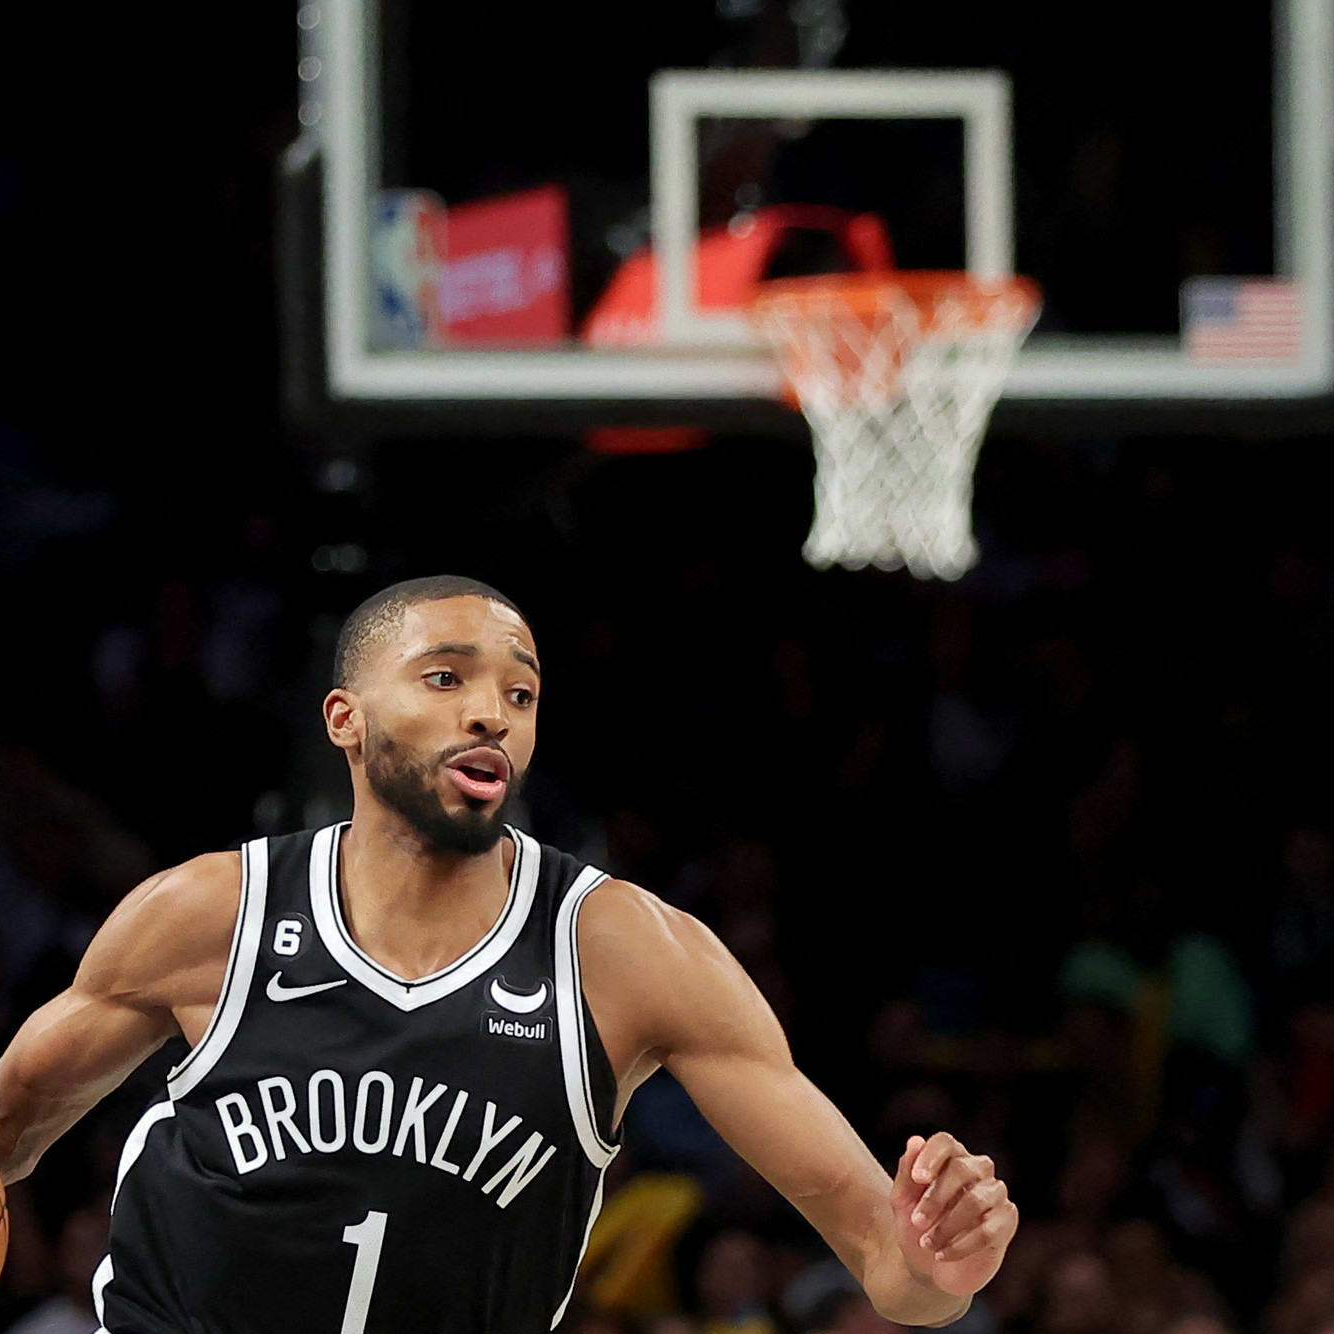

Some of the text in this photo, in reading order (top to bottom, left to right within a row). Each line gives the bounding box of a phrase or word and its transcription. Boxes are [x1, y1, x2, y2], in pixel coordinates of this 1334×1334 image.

[273, 919, 303, 956] 6
[487, 1018, 546, 1040] Webull
[215, 1068, 557, 1210] BROOKLYN
